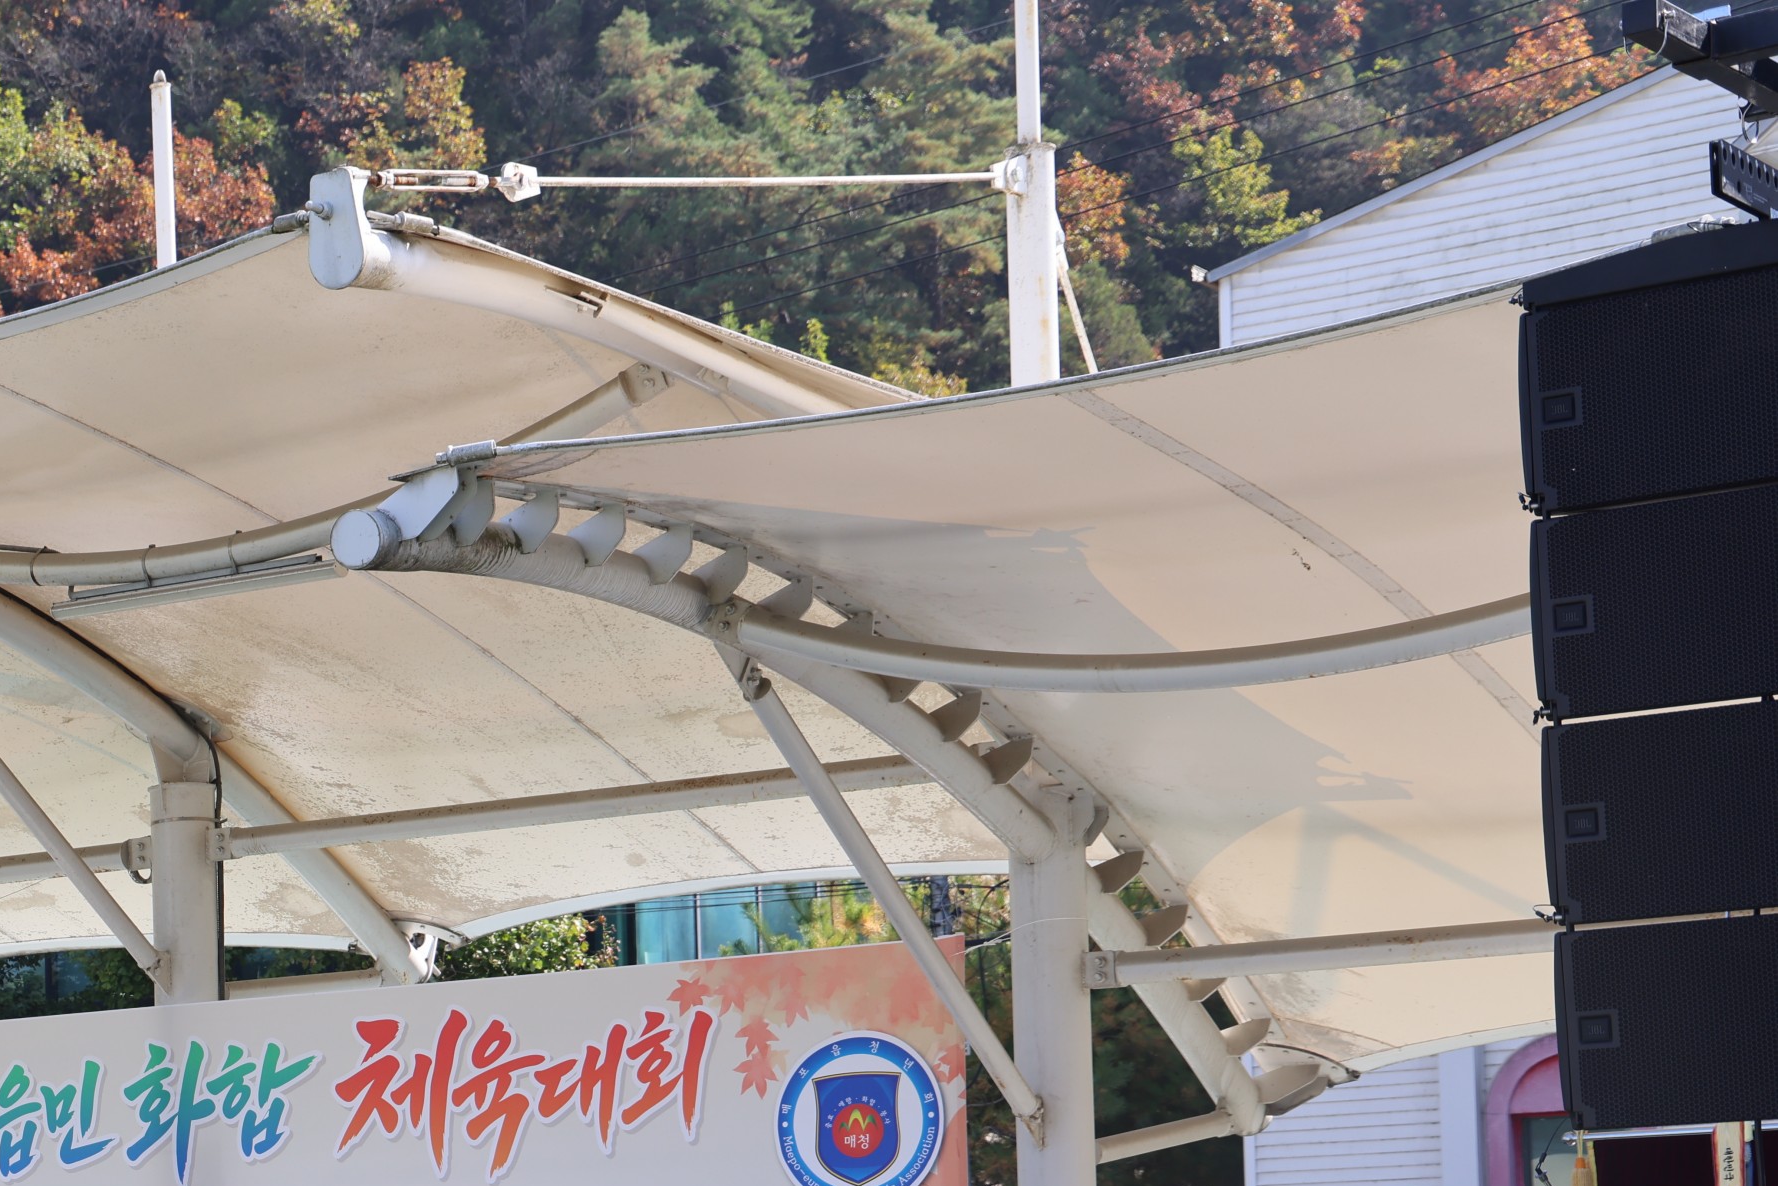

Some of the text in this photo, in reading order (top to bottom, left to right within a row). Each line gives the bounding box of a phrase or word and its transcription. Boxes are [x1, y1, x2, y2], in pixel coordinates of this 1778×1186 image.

[124, 1040, 319, 1186] 화합
[335, 1008, 716, 1179] 체육대회
[844, 1133, 870, 1150] 매청
[898, 1126, 936, 1186] Association
[1724, 1147, 1735, 1182] 대한민국
